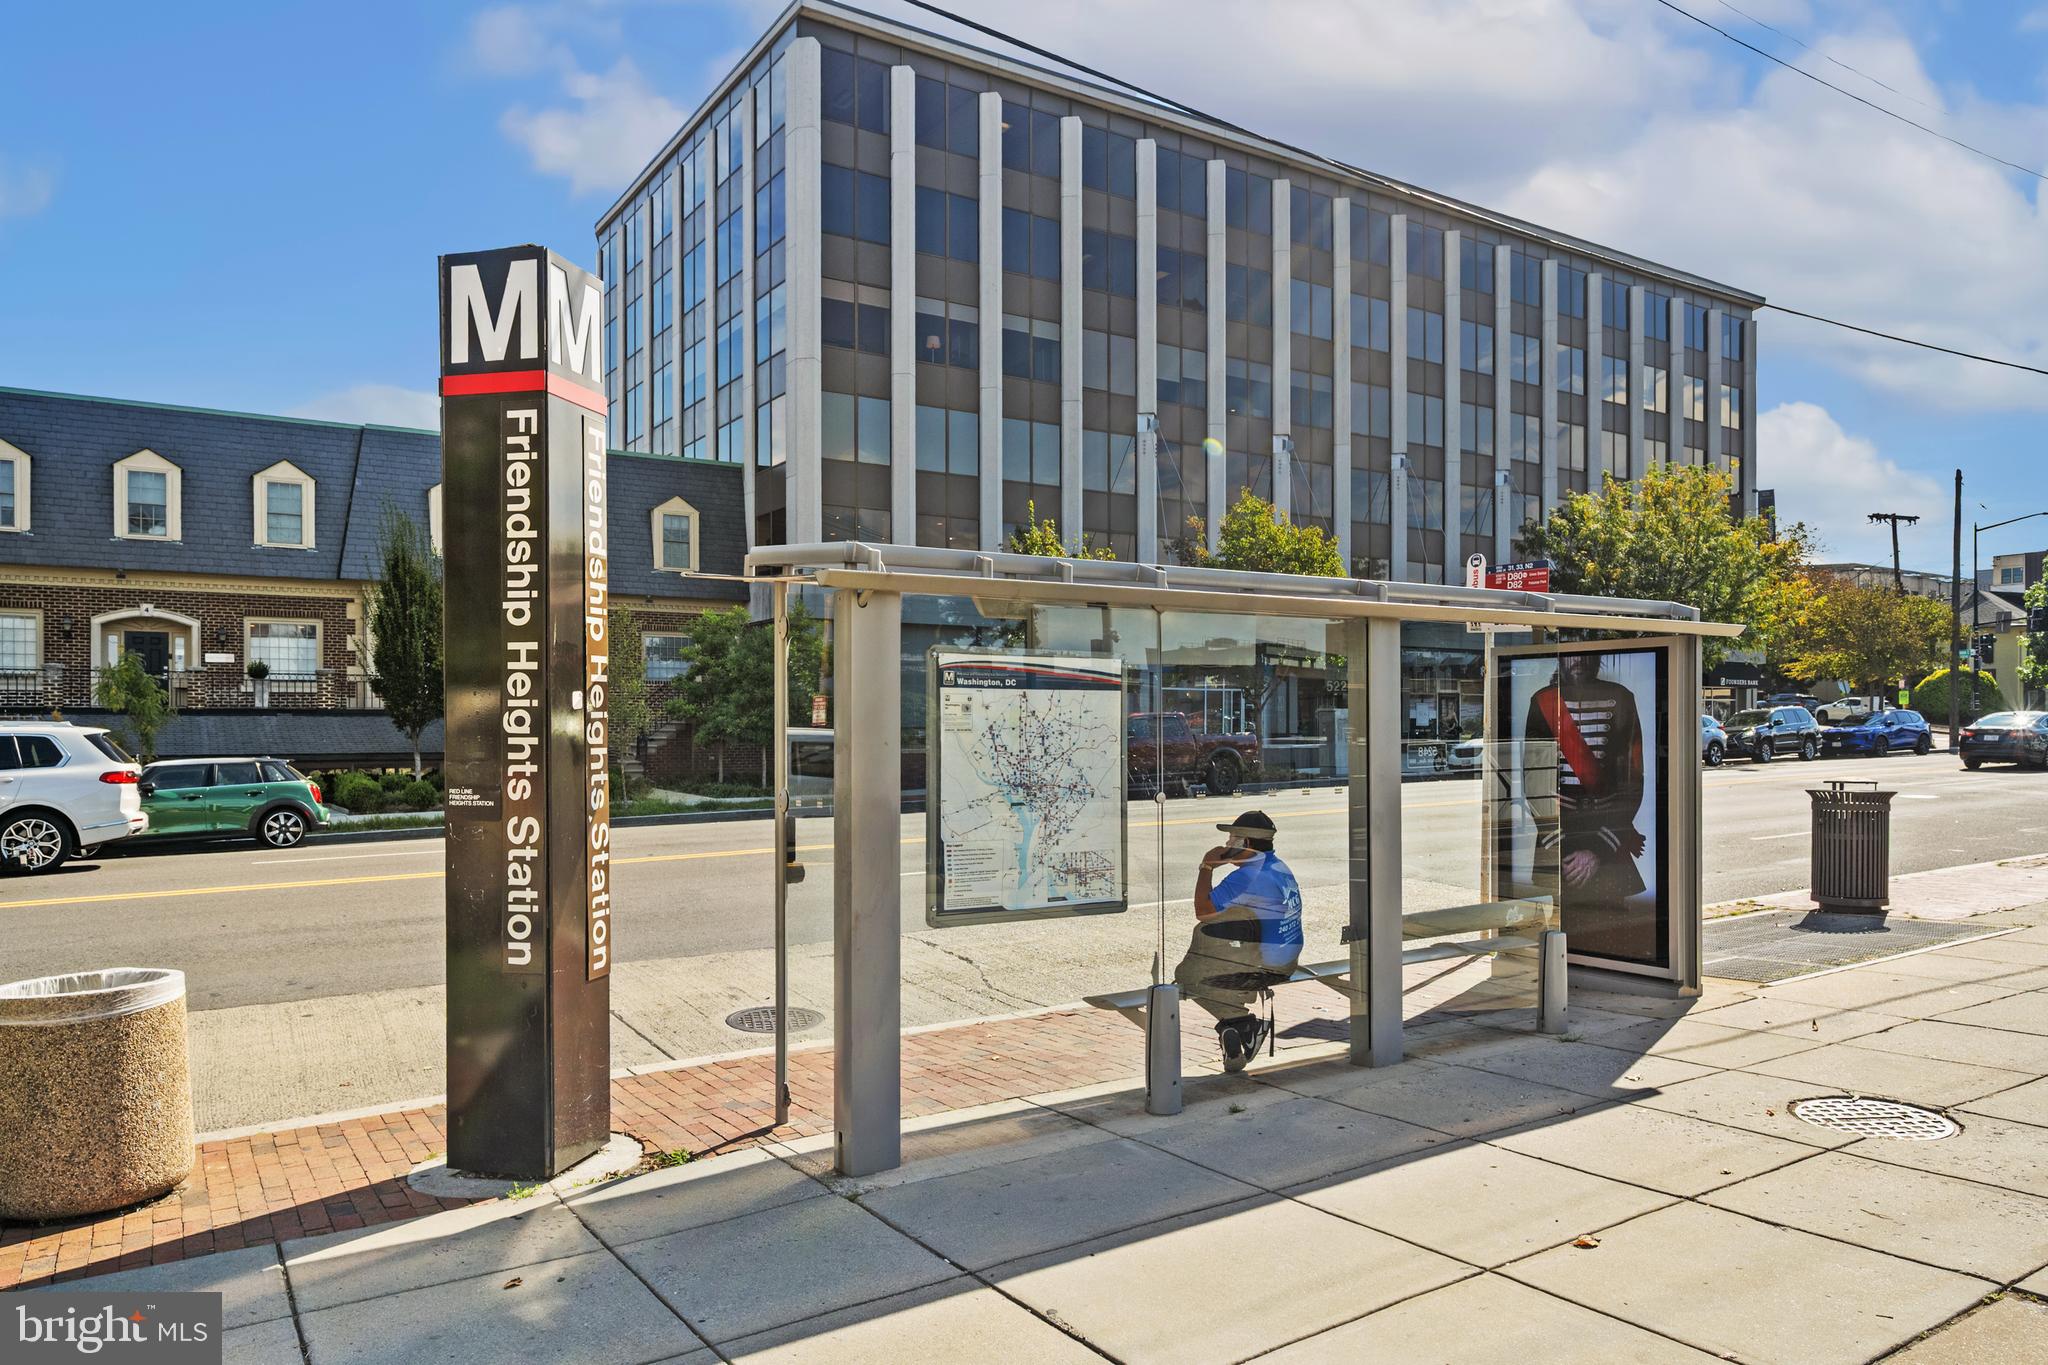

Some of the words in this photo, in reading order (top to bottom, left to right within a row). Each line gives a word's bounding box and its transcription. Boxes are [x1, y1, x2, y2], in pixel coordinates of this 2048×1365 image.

[451, 259, 538, 364] M
[551, 263, 602, 383] M
[502, 408, 538, 626] Friendship
[586, 425, 607, 641] Friendship
[1507, 572, 1523, 581] D80
[1507, 581, 1523, 589] D82
[502, 641, 539, 801] Heights
[586, 655, 608, 810] Heights
[957, 677, 1003, 688] Washington,
[507, 816, 540, 966] Station
[591, 822, 610, 971] Station
